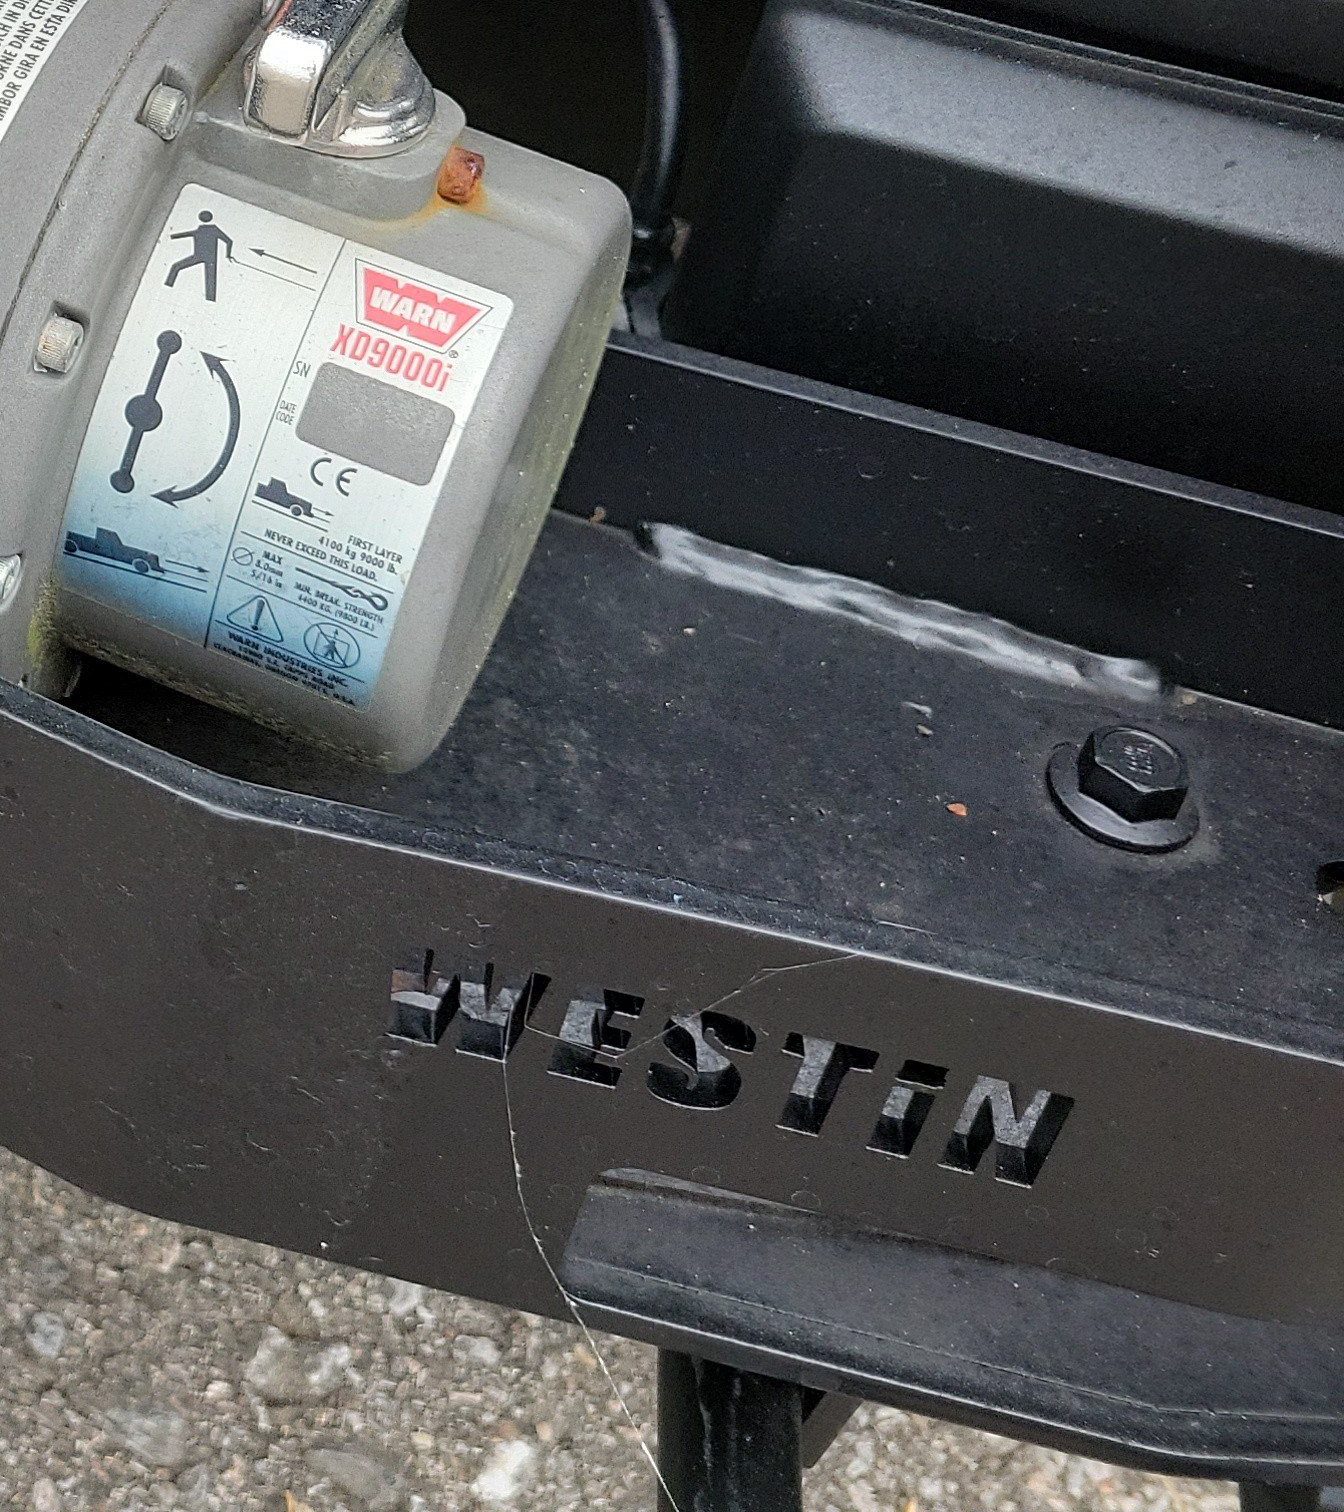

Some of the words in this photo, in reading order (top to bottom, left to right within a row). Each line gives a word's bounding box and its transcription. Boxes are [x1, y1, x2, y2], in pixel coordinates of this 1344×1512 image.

[5, 9, 22, 23] IN
[9, 21, 36, 49] DANS
[13, 53, 40, 80] GIRA
[30, 35, 50, 52] EN
[45, 14, 67, 37] ESTA
[369, 285, 456, 334] WARN
[292, 360, 311, 379] SN
[330, 323, 453, 392] XD9000i
[276, 410, 295, 426] CODE
[279, 400, 298, 414] DATE
[262, 550, 283, 565] MAX
[264, 528, 293, 548] NEVER
[296, 540, 327, 560] EXCEED
[329, 554, 350, 570] THIS
[351, 562, 378, 582] LOAD.
[319, 536, 343, 553] 4100
[345, 545, 356, 561] kg
[360, 550, 385, 569] 9000
[348, 535, 374, 554] FIRST
[375, 545, 403, 564] LAYER
[228, 631, 260, 651] WARN
